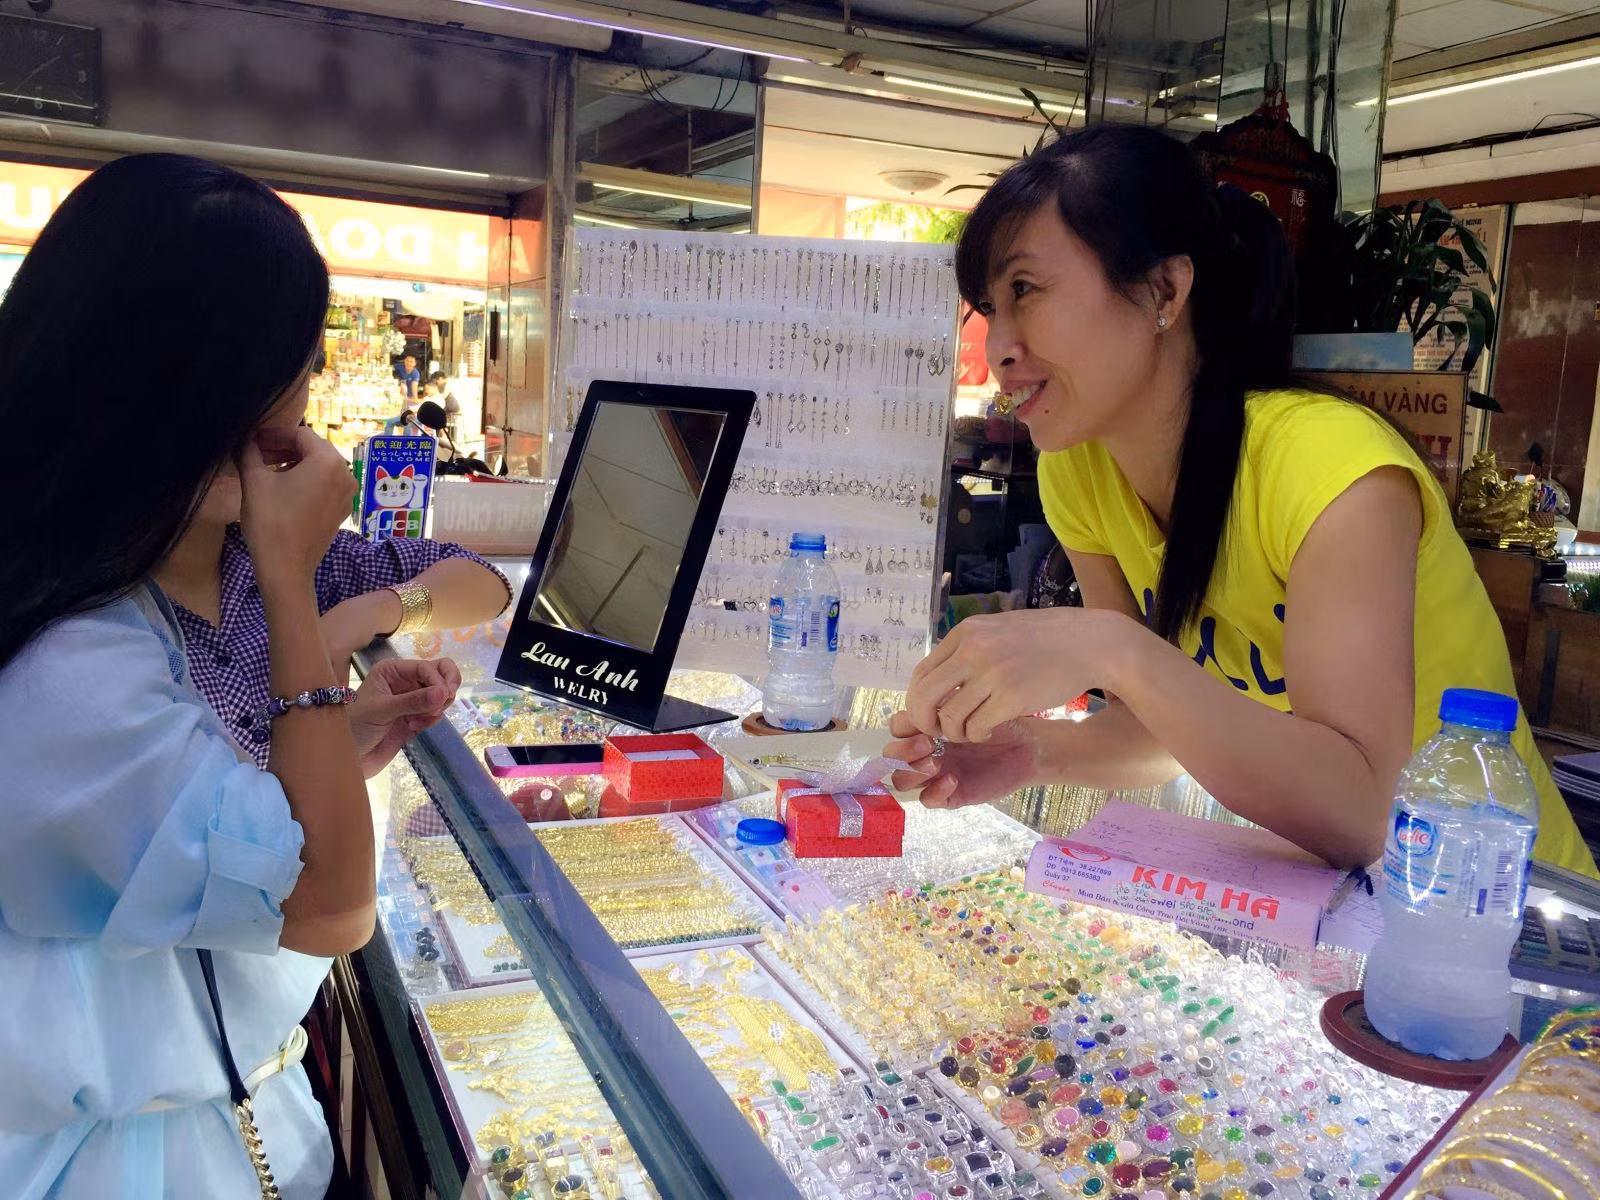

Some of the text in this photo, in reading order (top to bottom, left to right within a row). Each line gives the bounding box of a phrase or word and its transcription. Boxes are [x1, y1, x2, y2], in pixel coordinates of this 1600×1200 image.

[1383, 388, 1448, 415] VÀNG
[521, 642, 639, 692] Lan Anh
[1131, 865, 1208, 901] KIM
